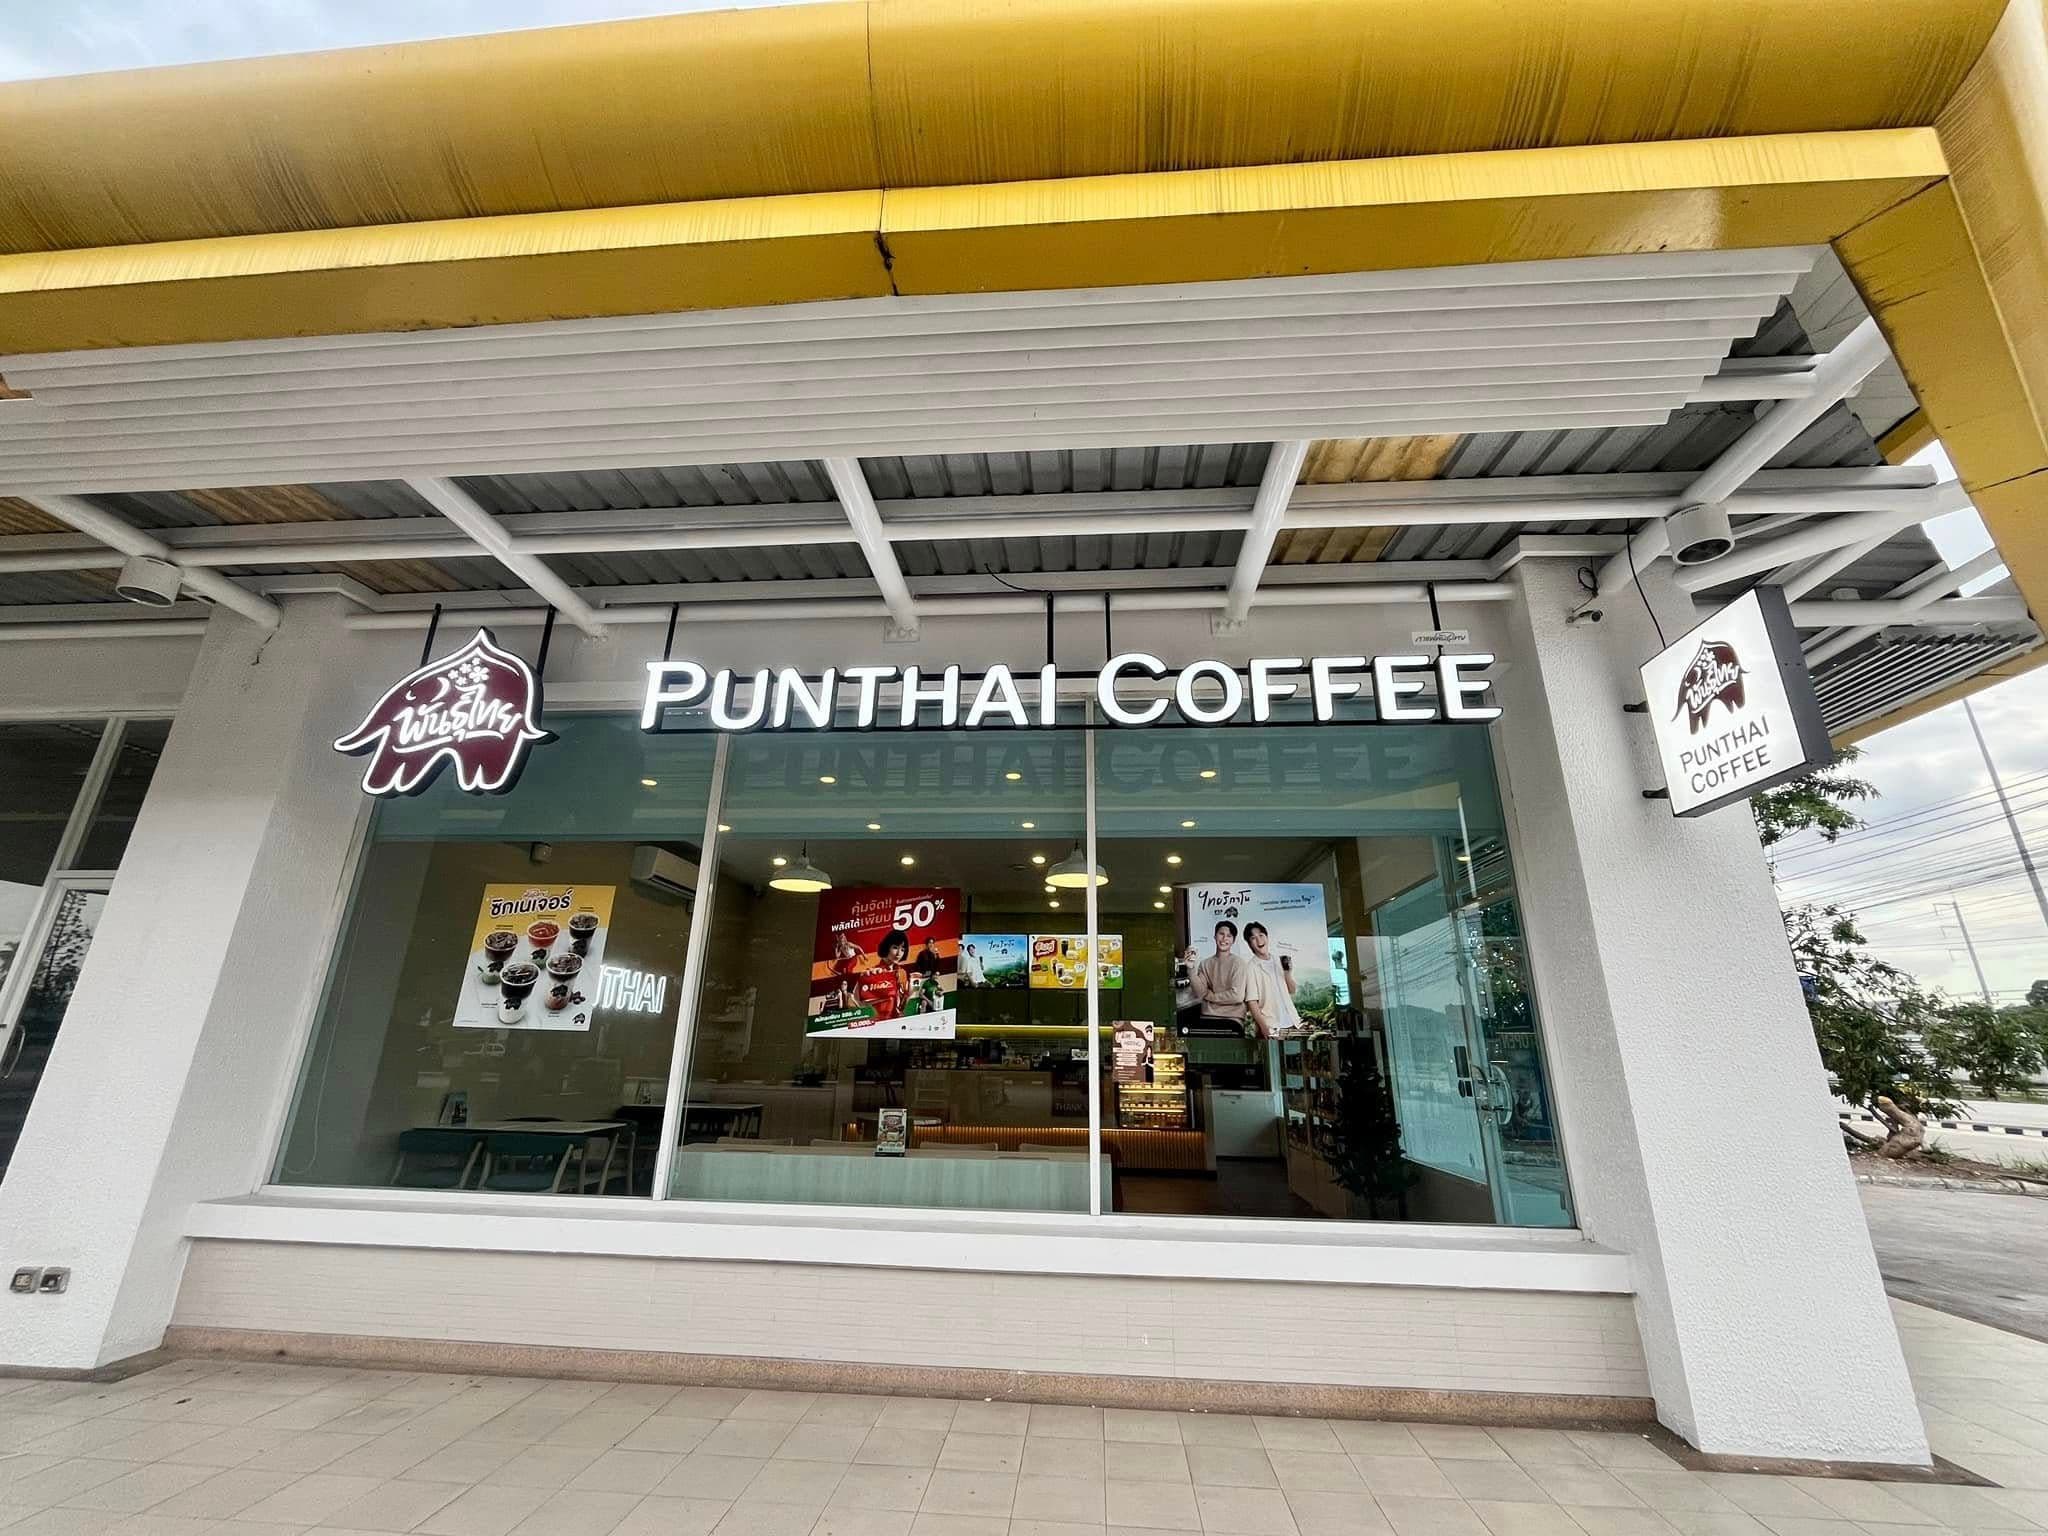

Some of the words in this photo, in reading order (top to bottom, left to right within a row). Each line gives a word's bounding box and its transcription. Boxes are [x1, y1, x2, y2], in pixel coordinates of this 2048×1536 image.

[640, 660, 1058, 731] PUNTHAI
[1097, 653, 1504, 726] COFFEE
[1679, 714, 1770, 774] PUNTHAI
[1691, 744, 1772, 794] COFFEE
[892, 898, 945, 931] 50%
[592, 965, 667, 1014] THAI
